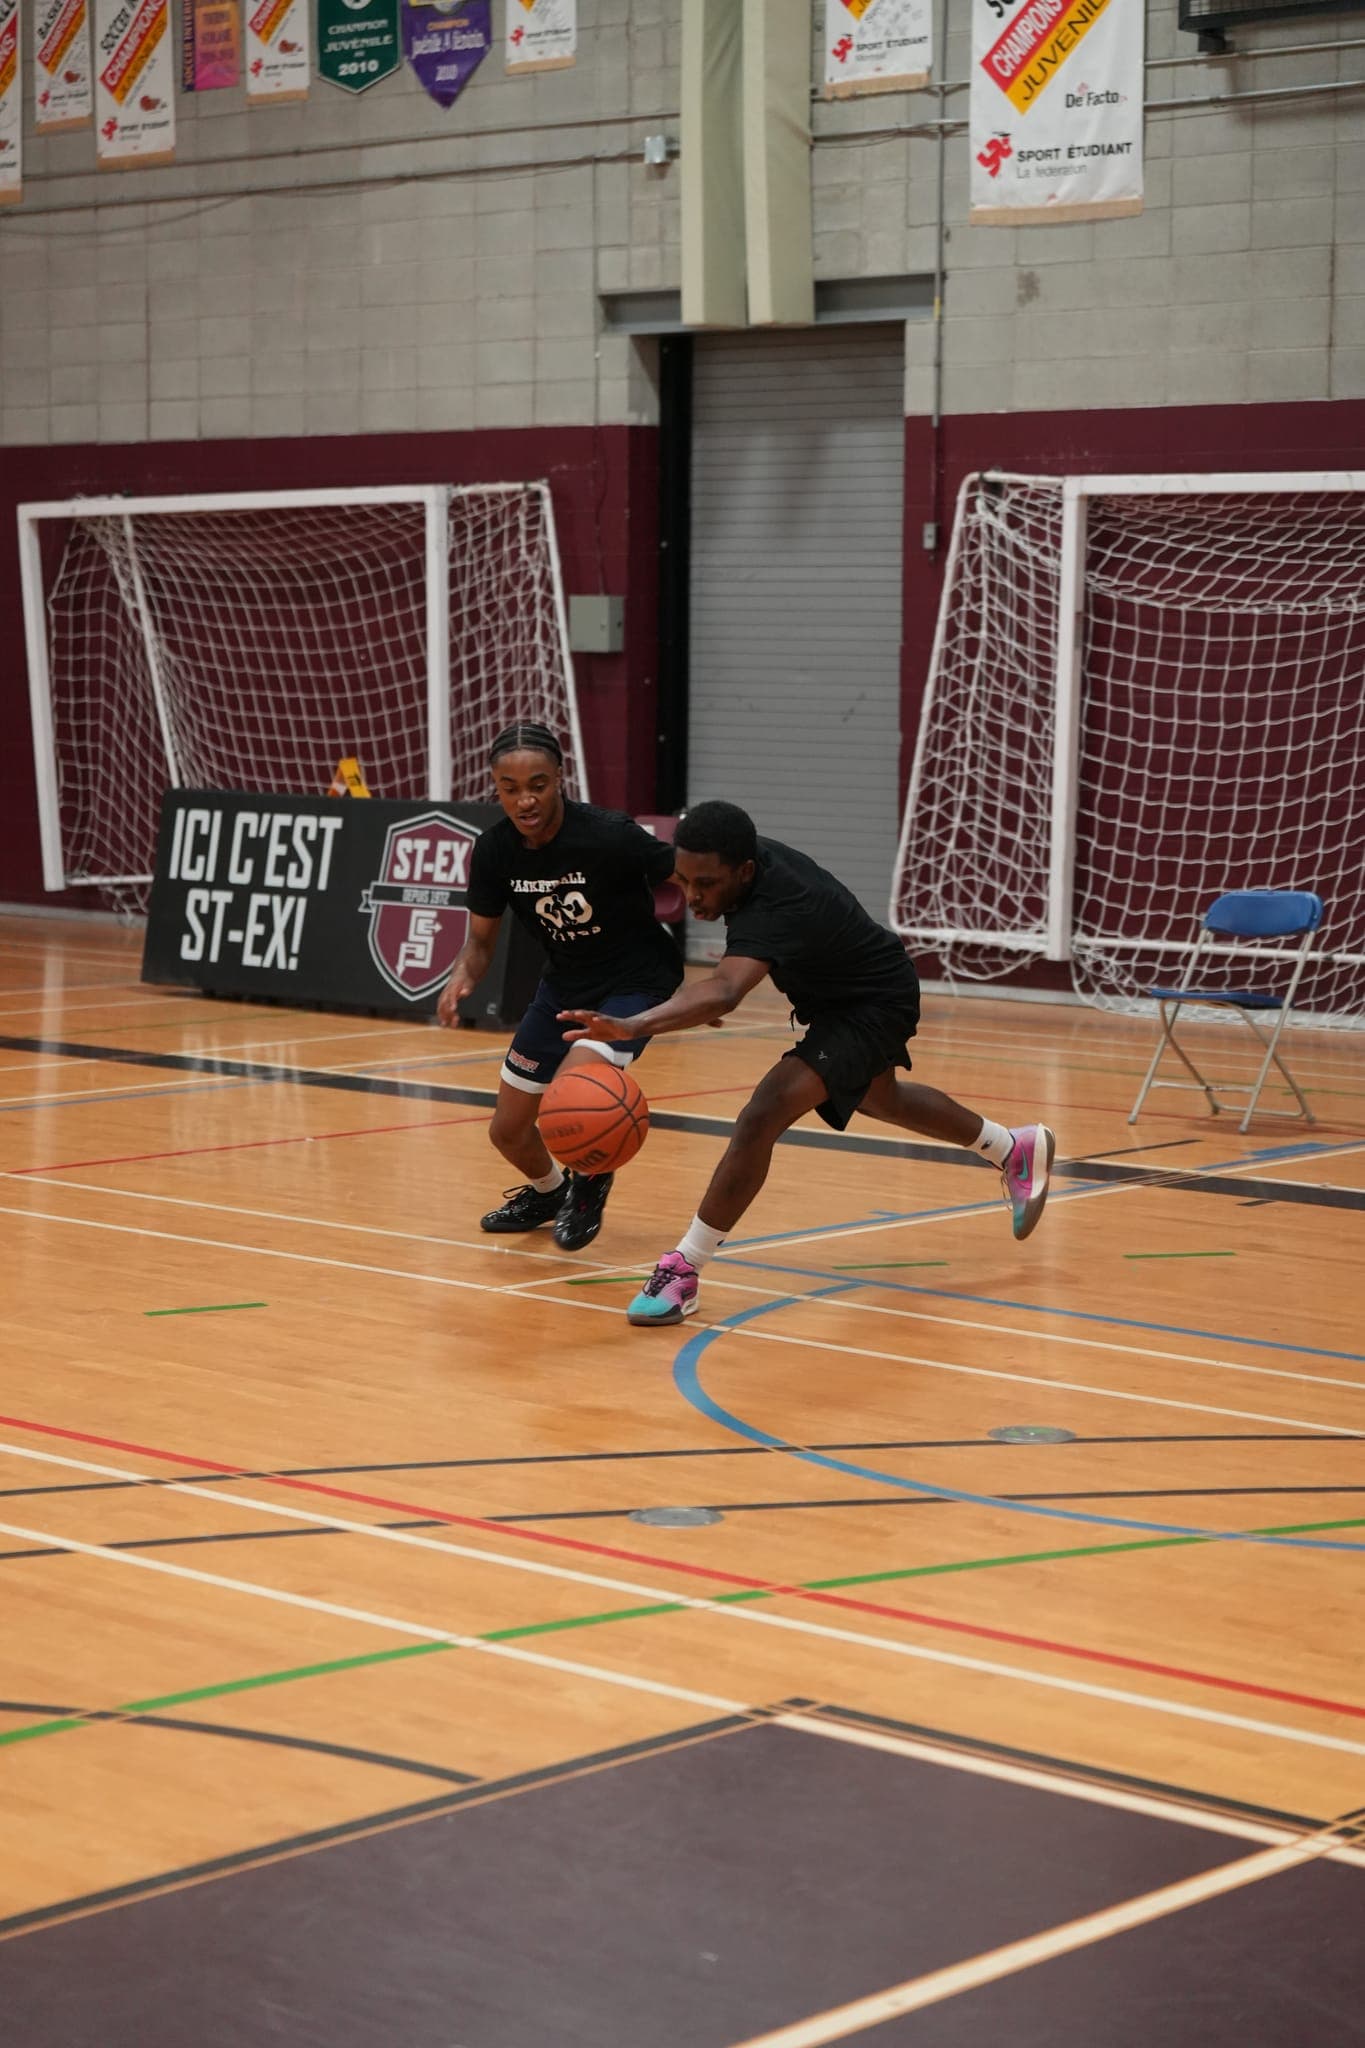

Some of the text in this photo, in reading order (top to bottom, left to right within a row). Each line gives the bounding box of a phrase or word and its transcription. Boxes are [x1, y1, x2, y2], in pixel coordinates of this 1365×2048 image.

[328, 19, 388, 34] CHAMPION
[338, 59, 379, 76] 2010
[1065, 90, 1120, 109] De Facto
[1017, 142, 1133, 162] SPORT ÉTUDIANT
[169, 807, 344, 891] ICI C'EST
[393, 838, 470, 884] ST-EX
[511, 871, 587, 893] ASKETALL
[180, 887, 308, 971] ST-EX!
